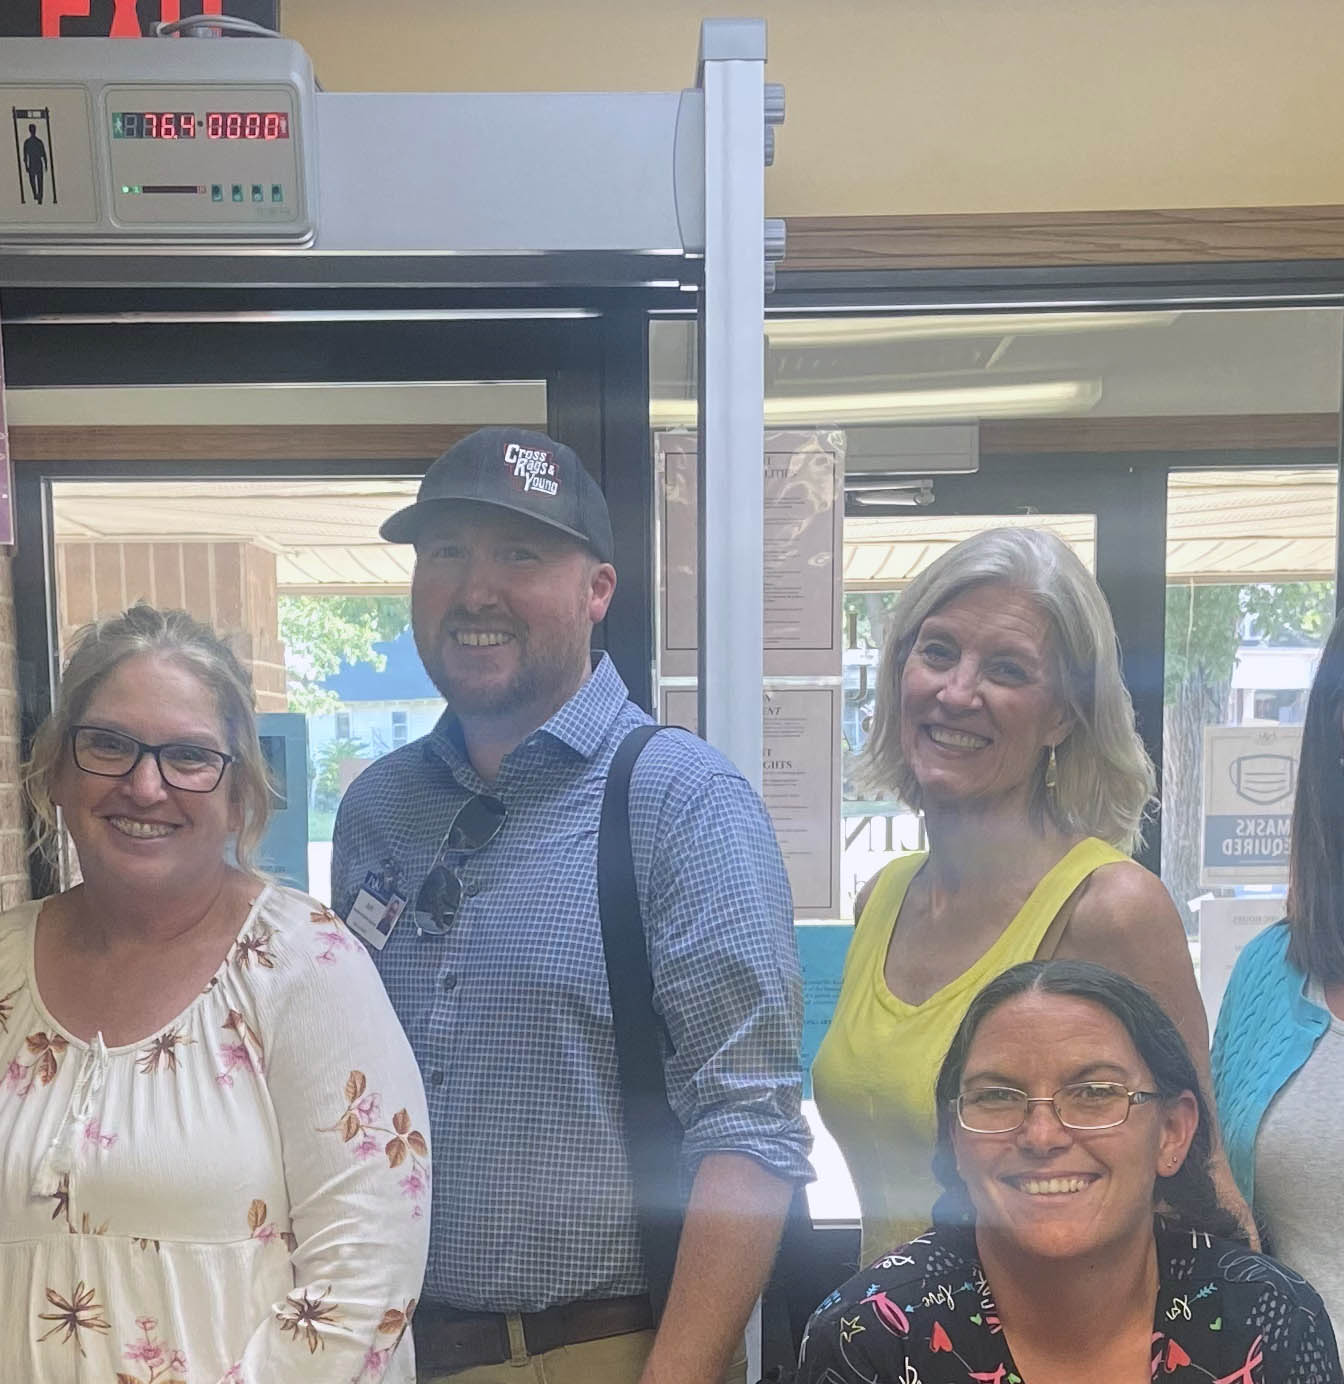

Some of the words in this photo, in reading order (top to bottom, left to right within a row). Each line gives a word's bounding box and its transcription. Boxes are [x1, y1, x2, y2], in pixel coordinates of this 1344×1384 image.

[505, 444, 547, 464] Cross
[514, 458, 548, 477] Rags
[524, 472, 558, 496] Young
